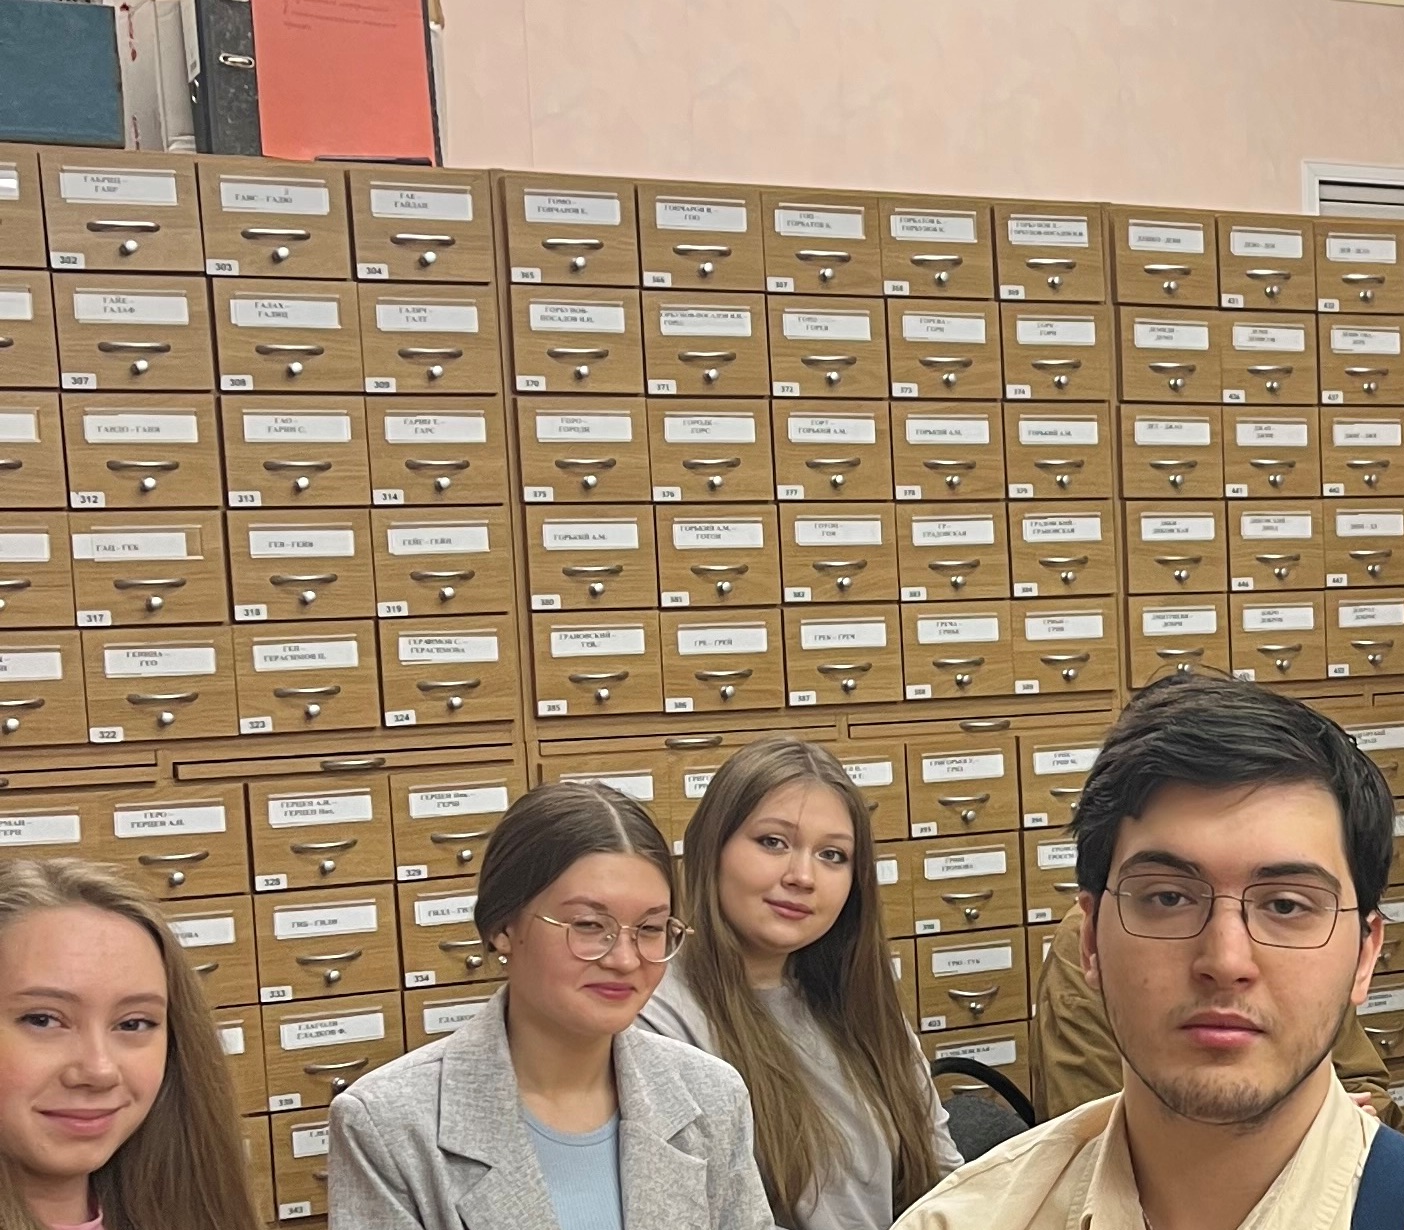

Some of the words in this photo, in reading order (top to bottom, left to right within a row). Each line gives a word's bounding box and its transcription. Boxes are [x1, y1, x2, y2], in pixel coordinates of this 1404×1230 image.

[60, 256, 78, 265] 302
[216, 263, 232, 272] 303
[366, 267, 382, 275] 304
[71, 377, 89, 385] 307
[80, 495, 98, 504] 312
[238, 495, 255, 503] 313
[382, 493, 398, 501] 314
[244, 608, 261, 617] 318
[386, 605, 402, 613] 319
[86, 614, 104, 623] 317
[99, 731, 117, 739] 322
